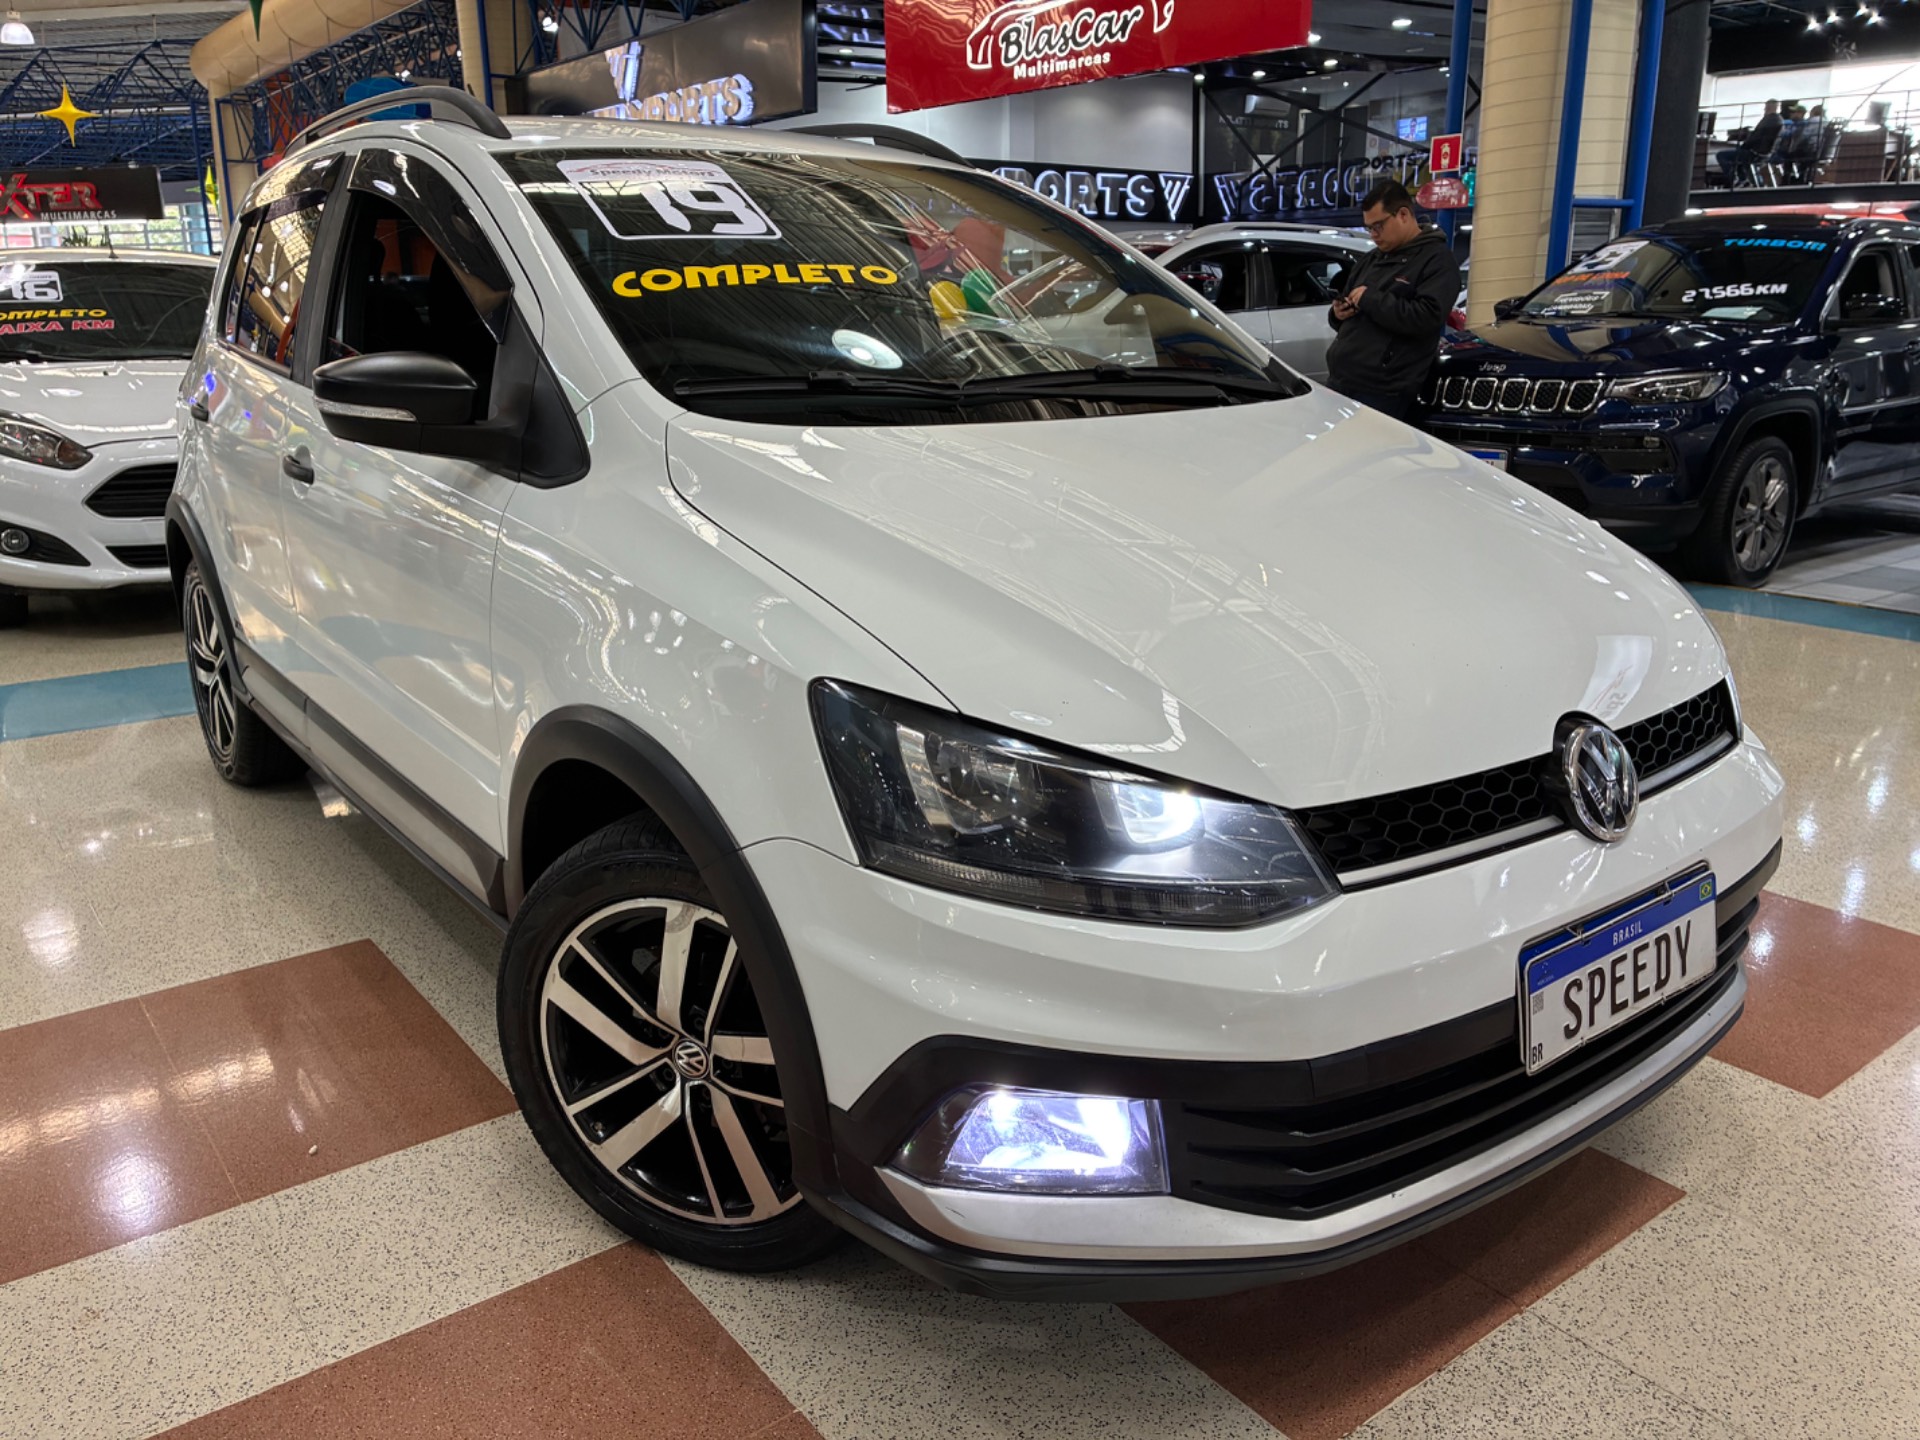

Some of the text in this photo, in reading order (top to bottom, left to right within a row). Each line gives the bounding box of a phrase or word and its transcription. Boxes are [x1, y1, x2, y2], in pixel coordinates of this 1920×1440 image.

[999, 5, 1145, 67] BlasCar
[1013, 52, 1112, 79] Multimarcas
[40, 210, 117, 221] MULTIMARCAS
[611, 264, 898, 298] COMPLETO
[71, 319, 115, 330] KM
[1612, 920, 1643, 946] BRASIL
[1563, 919, 1691, 1040] SPEEDY
[1532, 1042, 1543, 1065] BR
